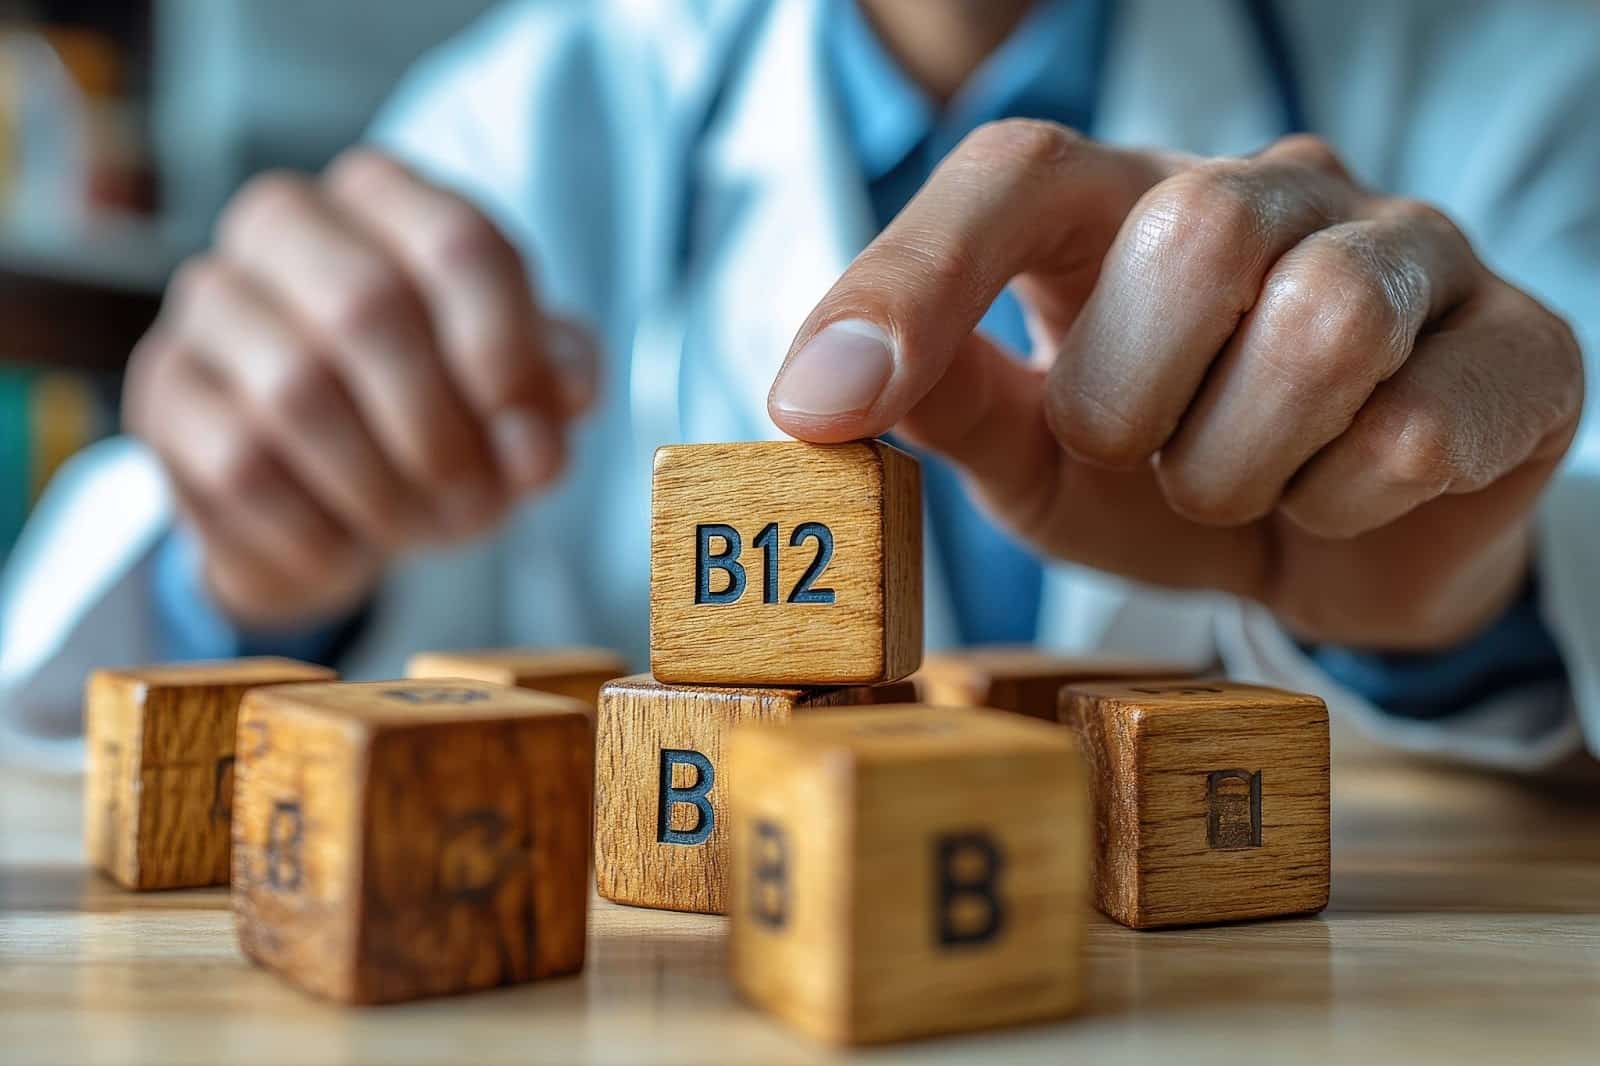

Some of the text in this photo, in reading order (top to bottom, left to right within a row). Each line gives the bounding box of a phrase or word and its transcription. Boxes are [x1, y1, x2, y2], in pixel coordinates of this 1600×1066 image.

[694, 521, 836, 605] B12
[657, 748, 715, 846] B
[931, 830, 1007, 950] B
